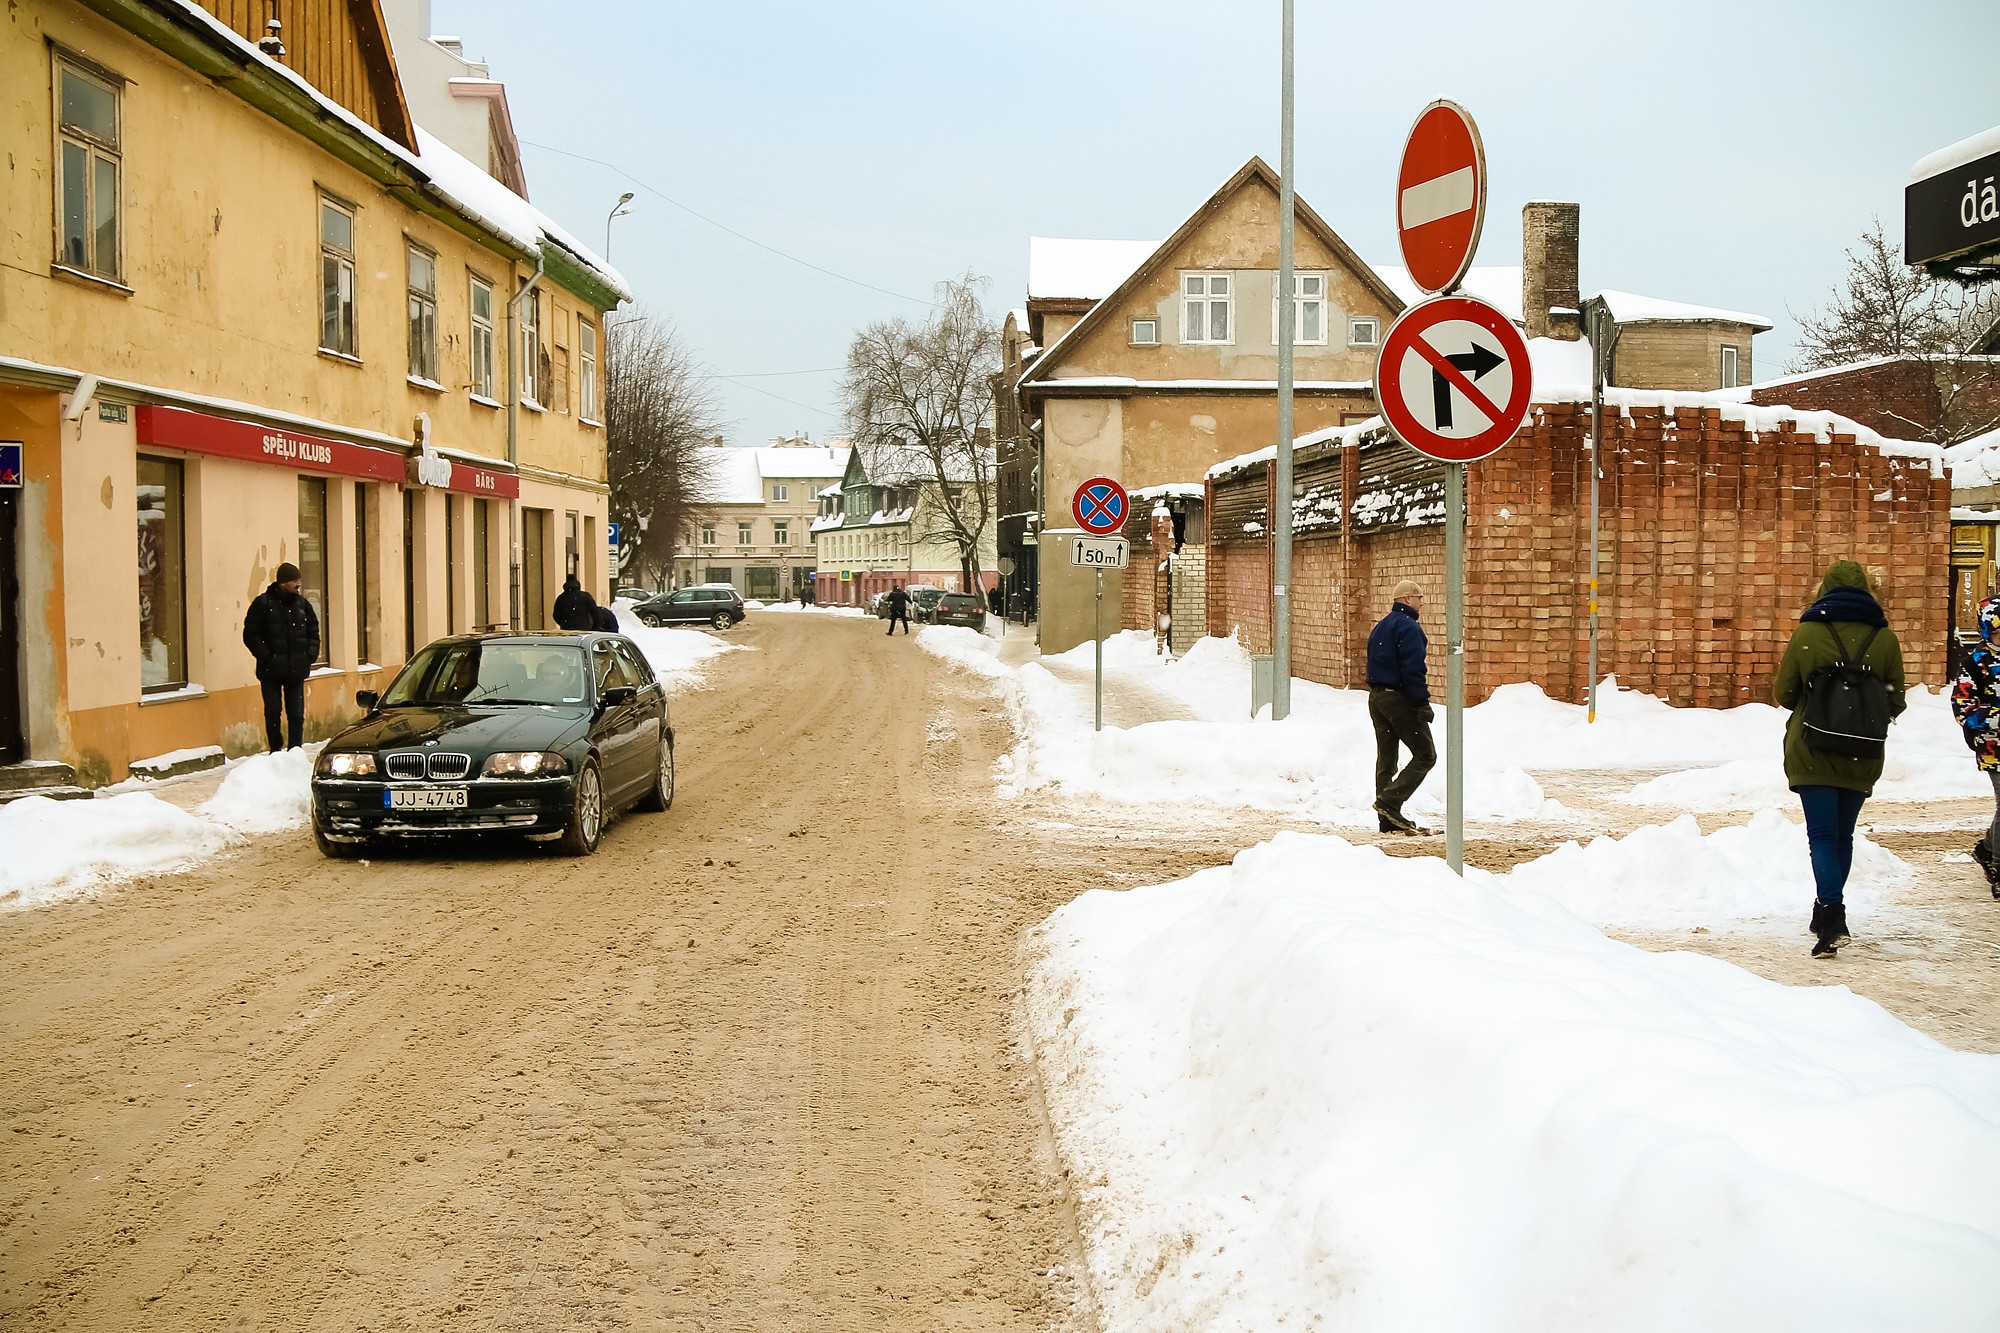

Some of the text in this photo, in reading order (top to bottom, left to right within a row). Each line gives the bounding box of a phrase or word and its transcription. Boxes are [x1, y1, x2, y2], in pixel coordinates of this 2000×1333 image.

[263, 434, 332, 464] SPĒĻU KLUBS
[475, 472, 495, 490] BĀRS
[395, 792, 465, 806] JJ-4748
